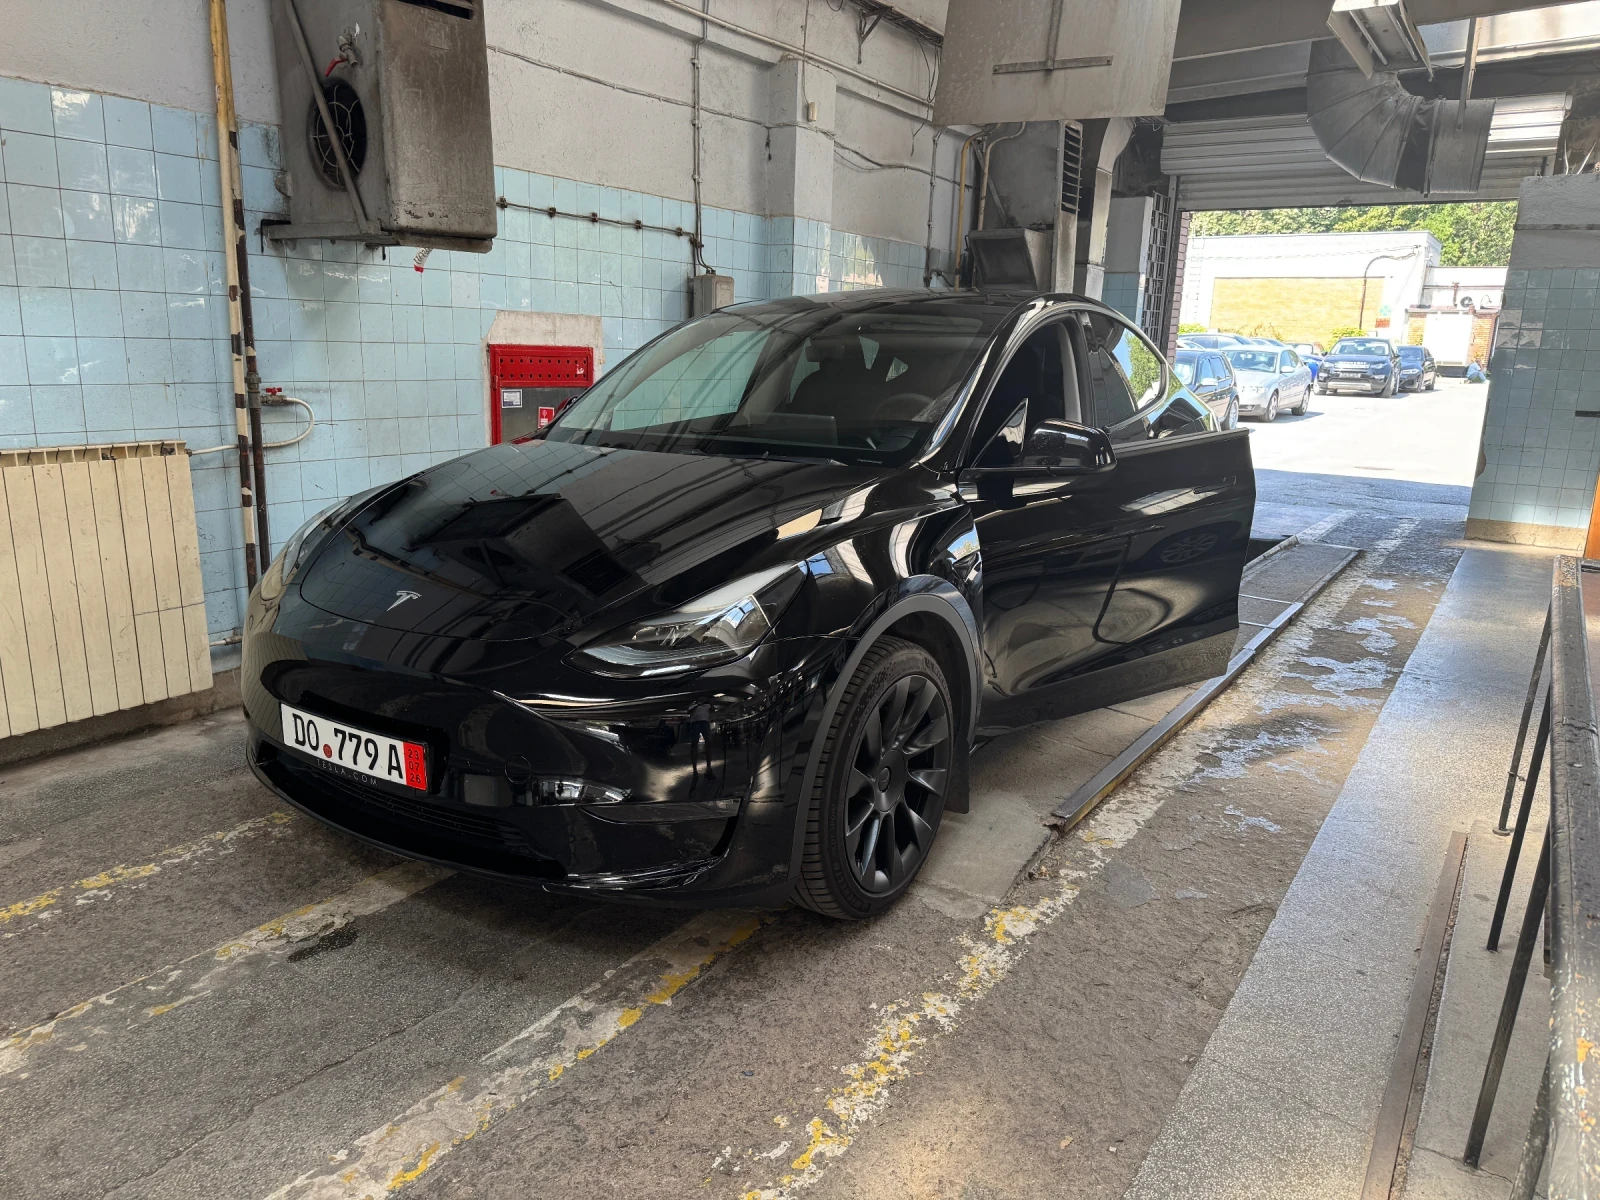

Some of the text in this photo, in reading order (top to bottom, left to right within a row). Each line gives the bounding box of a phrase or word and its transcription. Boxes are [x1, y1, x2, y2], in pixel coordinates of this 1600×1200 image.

[293, 713, 404, 780] DO 779 A
[407, 748, 420, 760] 23
[316, 759, 378, 786] TESLA.COM
[407, 760, 420, 772] 07
[409, 772, 422, 785] 26
[831, 861, 863, 909] MICHELIN
